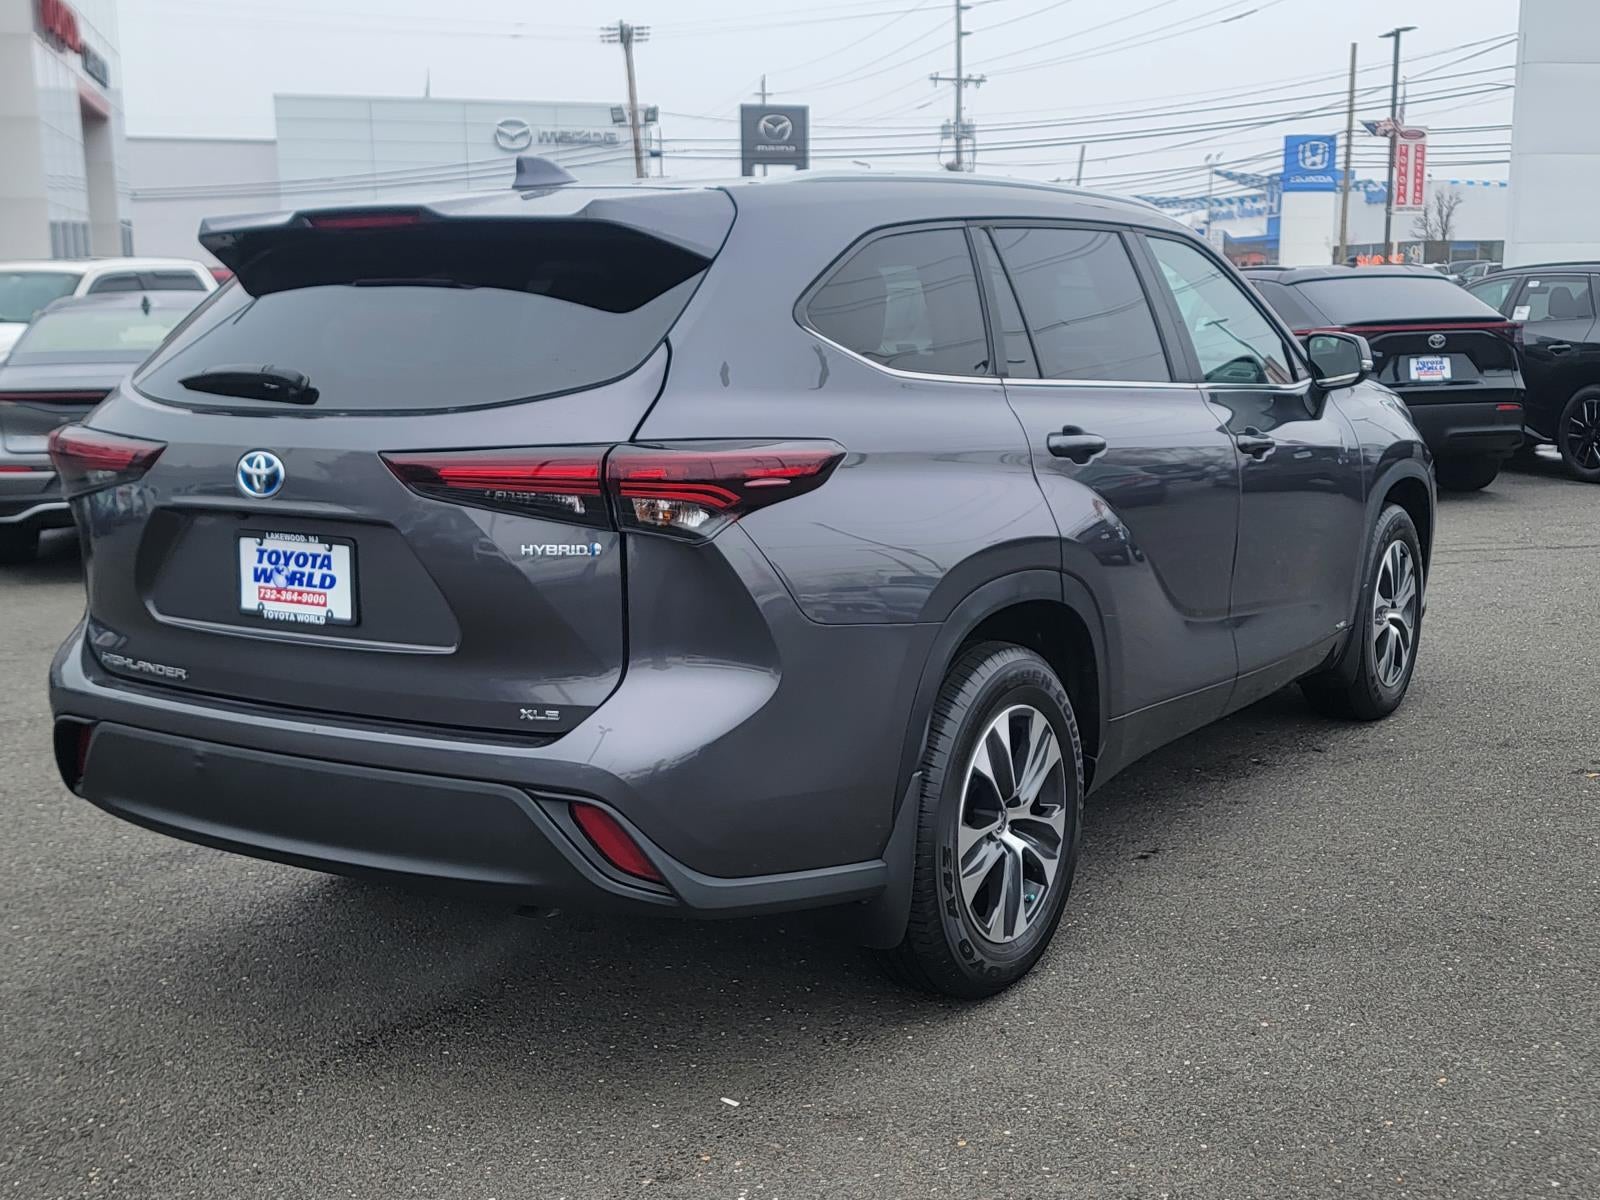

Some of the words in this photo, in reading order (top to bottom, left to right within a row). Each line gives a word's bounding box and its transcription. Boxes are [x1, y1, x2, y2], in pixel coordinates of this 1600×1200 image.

[1398, 144, 1408, 204] TOYOTA
[308, 535, 319, 543] NJ
[520, 543, 588, 556] HYBRID
[256, 548, 332, 571] TOYOTA
[253, 565, 337, 590] WORLD
[259, 588, 326, 605] 732-364-9000
[263, 609, 295, 621] TOYOTA
[296, 612, 326, 625] WORLD
[101, 651, 188, 680] HIGHLANDER
[519, 707, 561, 721] XLE
